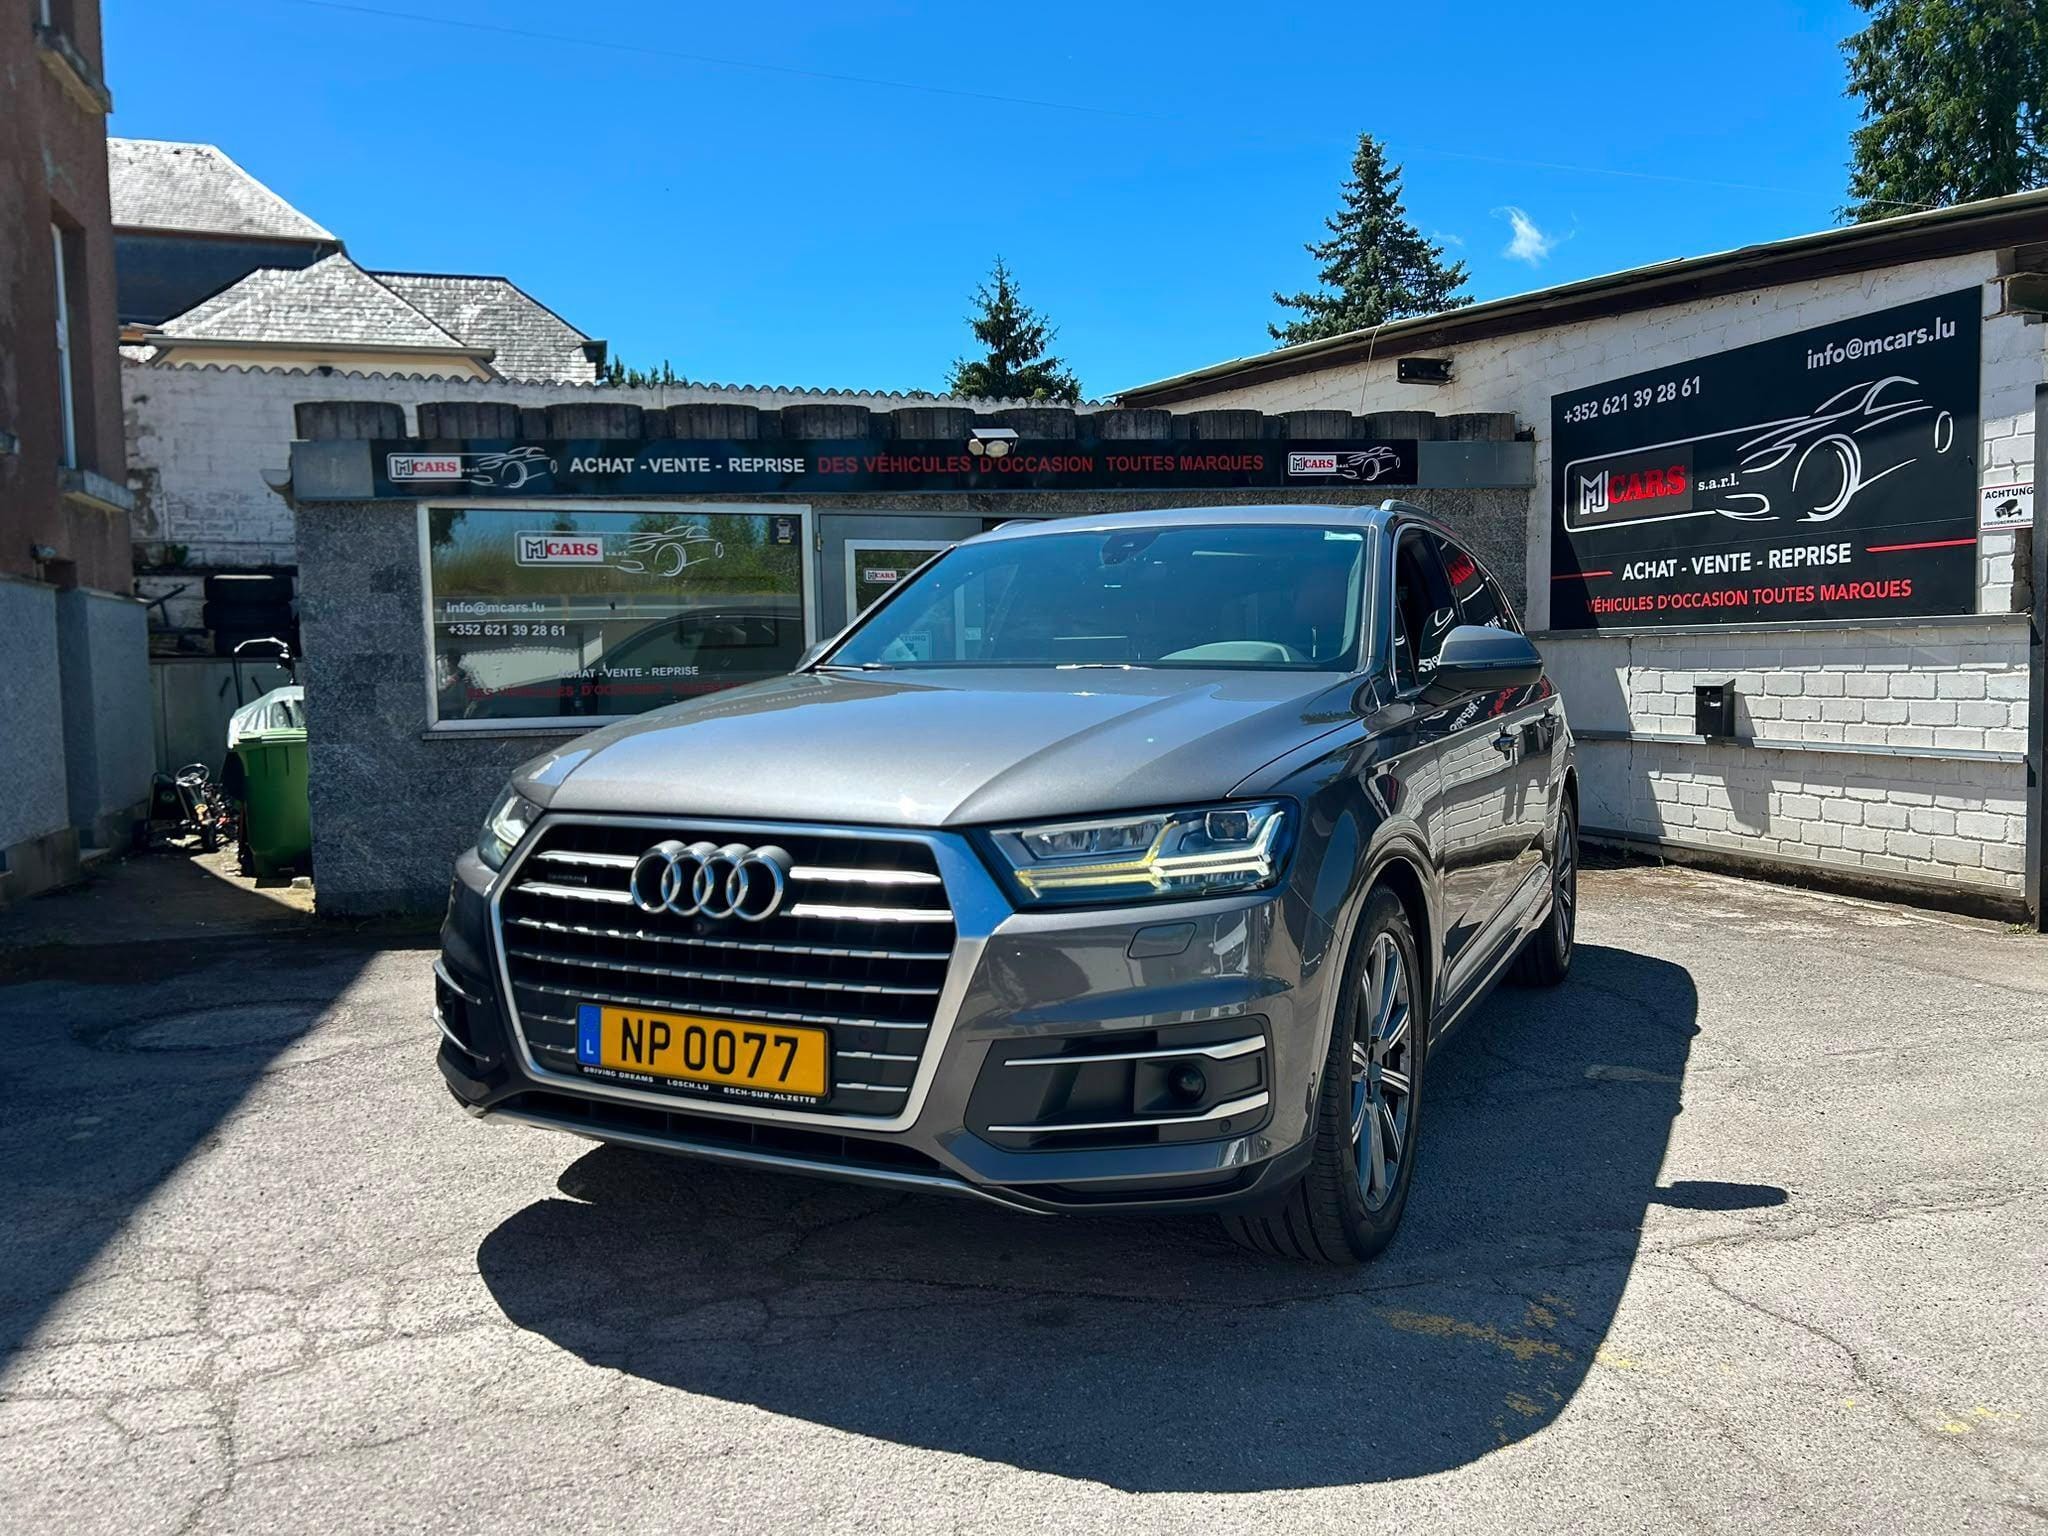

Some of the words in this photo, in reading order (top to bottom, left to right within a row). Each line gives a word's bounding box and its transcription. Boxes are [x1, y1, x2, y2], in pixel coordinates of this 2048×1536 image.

[1807, 316, 1956, 370] info@mcars.lu
[1563, 400, 1598, 424] +352
[1602, 393, 1628, 416] 621
[1633, 387, 1653, 409] 39
[1657, 382, 1677, 403] 28
[1681, 375, 1701, 397] 61
[569, 457, 635, 474] ACHAT
[728, 457, 806, 473] REPRISE
[817, 456, 859, 474] DES
[863, 452, 973, 474] VÉHICULES
[980, 455, 1094, 474] D'OCCASION
[1105, 455, 1175, 472] TOUTES
[1180, 455, 1264, 472] MARQUES
[1697, 473, 1740, 491] s.a.r.l.
[1984, 486, 2034, 500] ACHTUNG
[1622, 558, 1678, 582] ACHAT
[1691, 552, 1752, 576] VENTE
[1768, 542, 1852, 569] REPRISE
[1658, 589, 1749, 610] D'OCCASION
[1752, 585, 1815, 605] TOUTES
[1820, 579, 1913, 601] MARQUES
[446, 601, 545, 616] info@mcars.lu
[448, 624, 481, 636] +352
[484, 624, 508, 636] 621
[512, 624, 528, 636] 39
[531, 624, 548, 636] 28
[551, 625, 566, 637] 61
[651, 665, 699, 677] REPRISE
[585, 1038, 595, 1055] L
[621, 1017, 671, 1066] NP
[683, 1025, 799, 1083] 0077
[583, 1066, 617, 1077] DRIVING
[619, 1071, 654, 1083] DREAMS
[666, 1078, 710, 1091] LOSCH.LU
[723, 1086, 818, 1105] ESCH-SUR-ALZETTE
